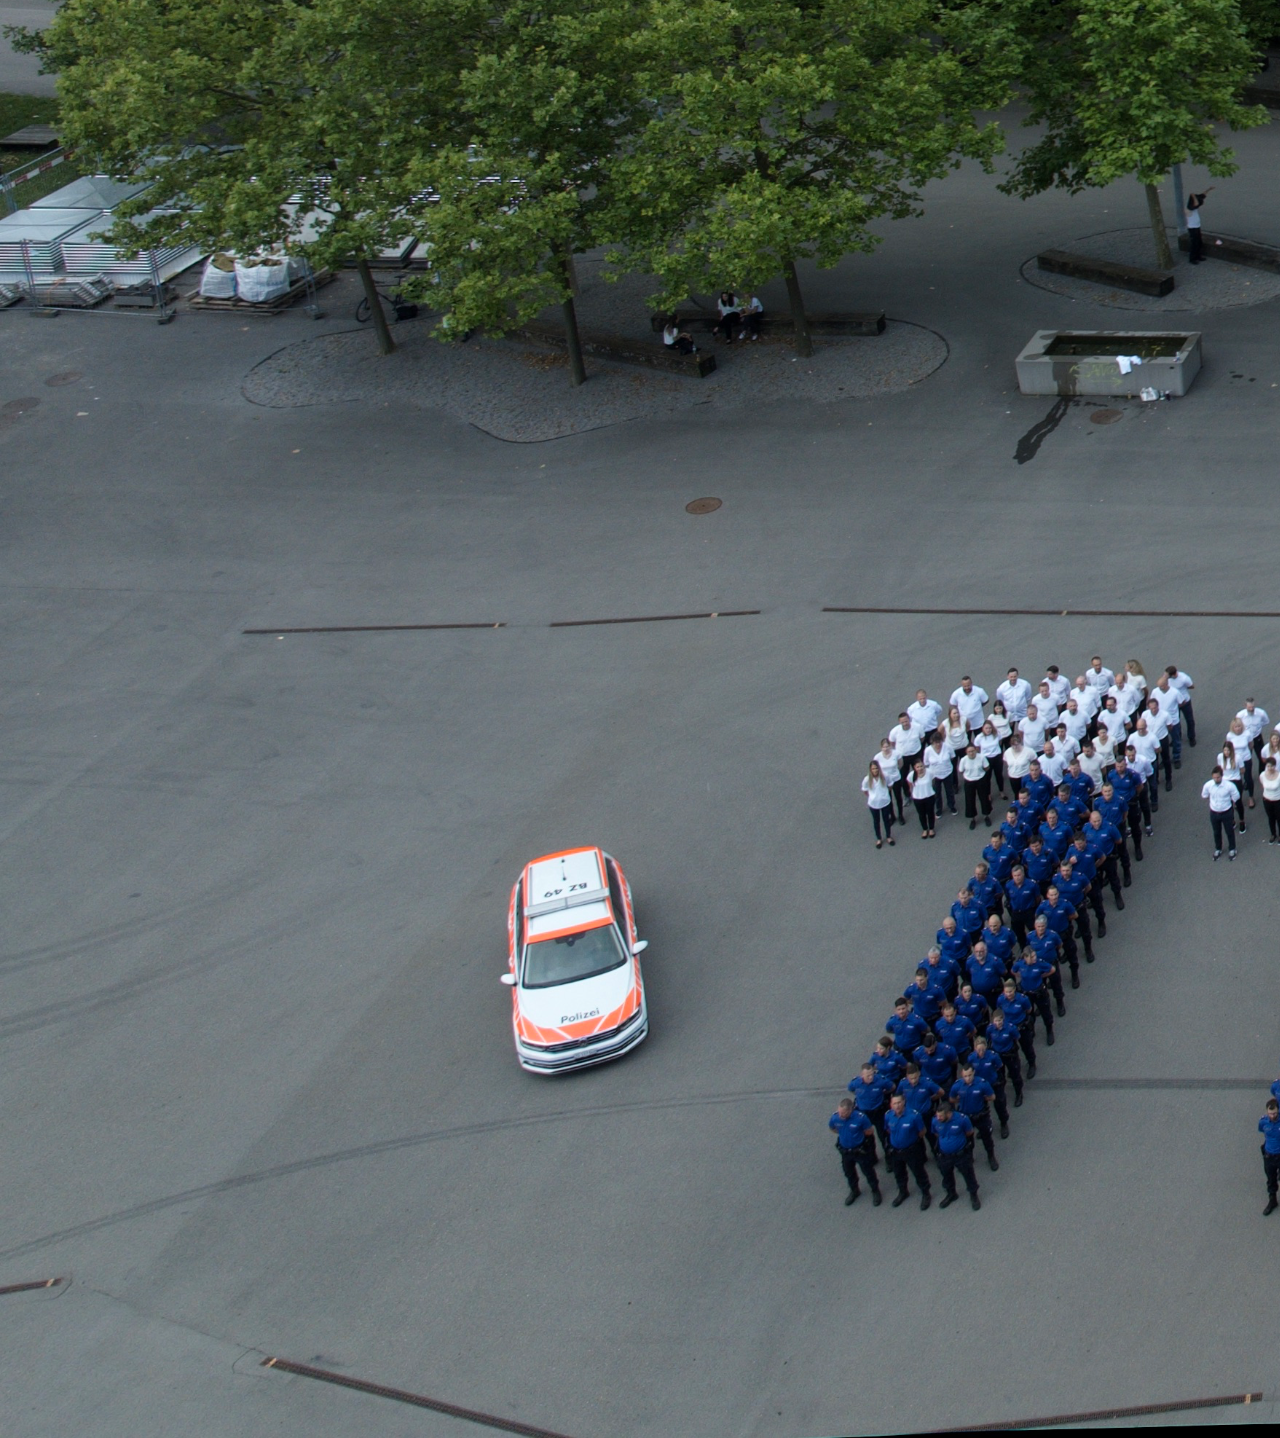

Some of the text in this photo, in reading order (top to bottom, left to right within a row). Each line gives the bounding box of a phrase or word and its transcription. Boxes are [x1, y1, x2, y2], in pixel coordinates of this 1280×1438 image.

[544, 882, 588, 899] BZ 49
[561, 1007, 600, 1024] Polizei
